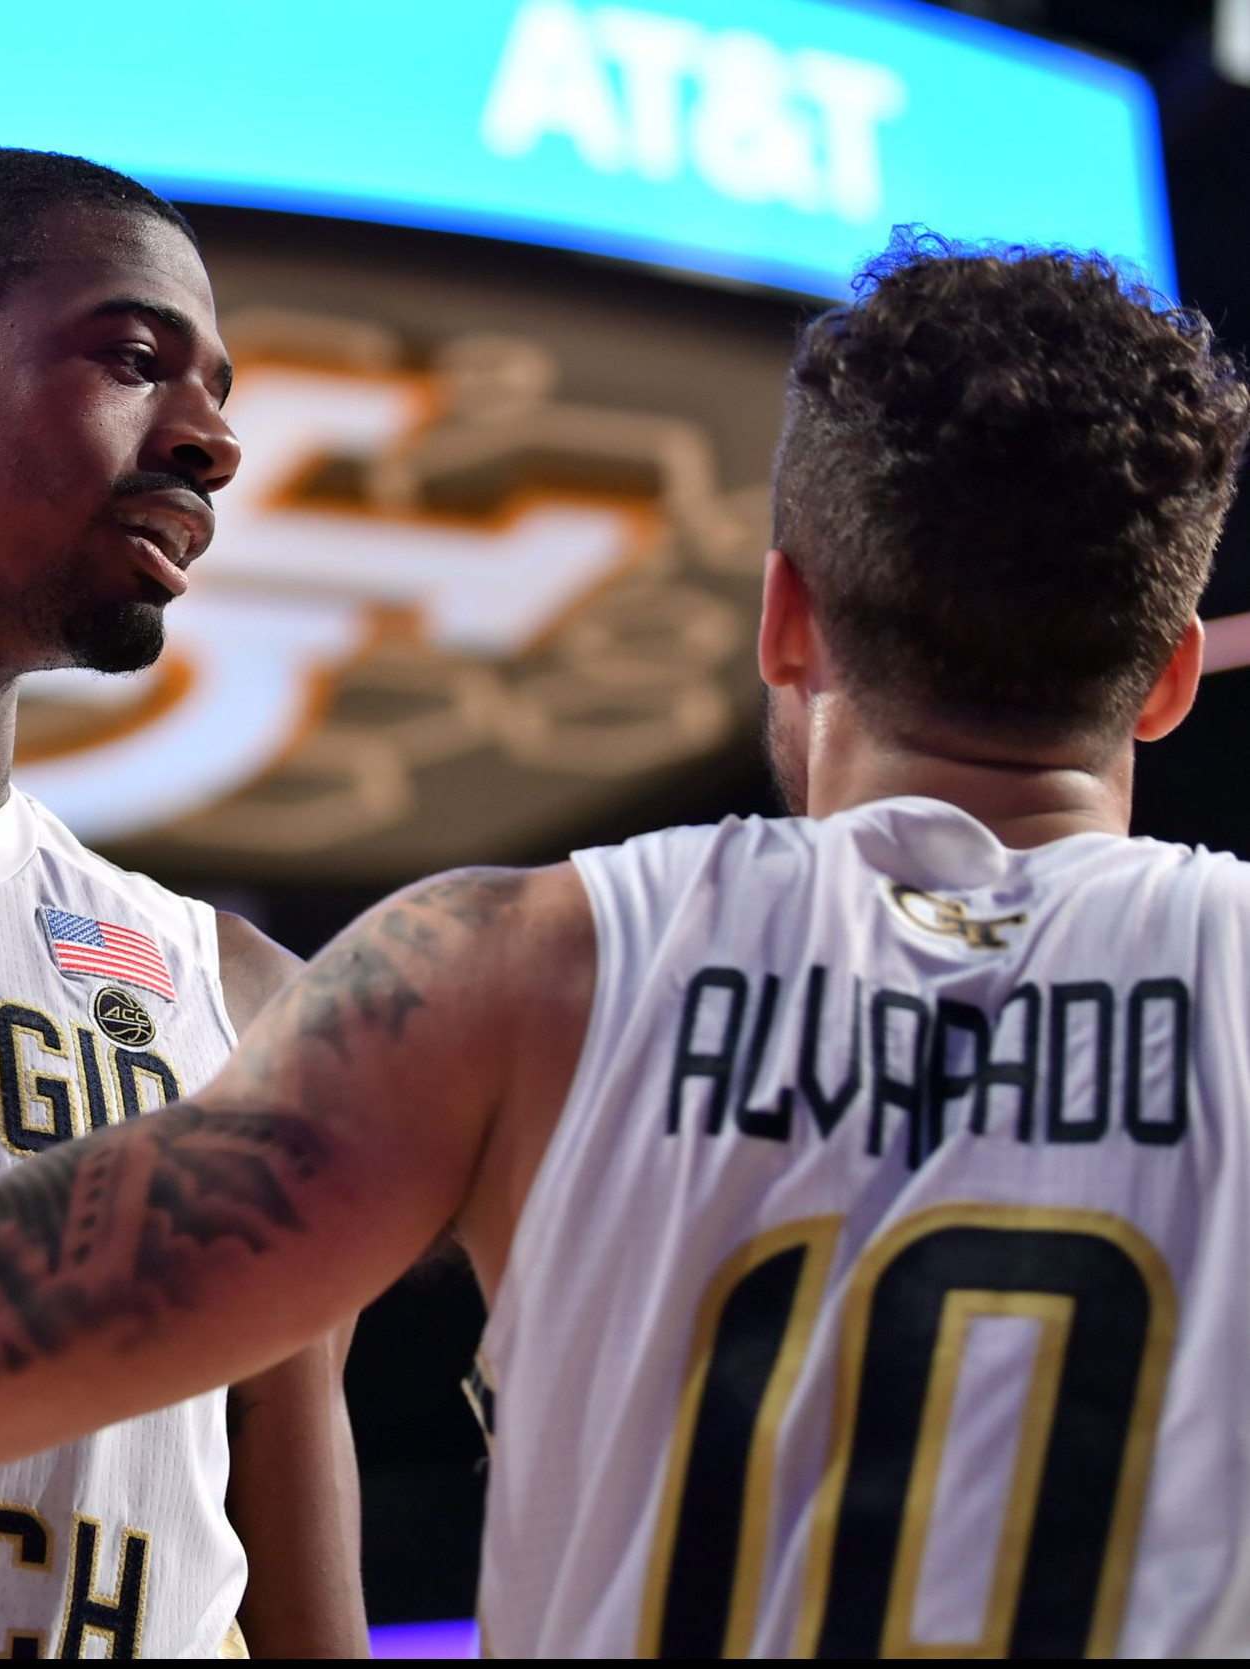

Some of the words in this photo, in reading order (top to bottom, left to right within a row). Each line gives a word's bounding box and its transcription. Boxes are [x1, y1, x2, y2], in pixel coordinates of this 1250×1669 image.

[481, 0, 907, 224] AT&T
[103, 1005, 150, 1025] ACC
[635, 1202, 1180, 1659] 10
